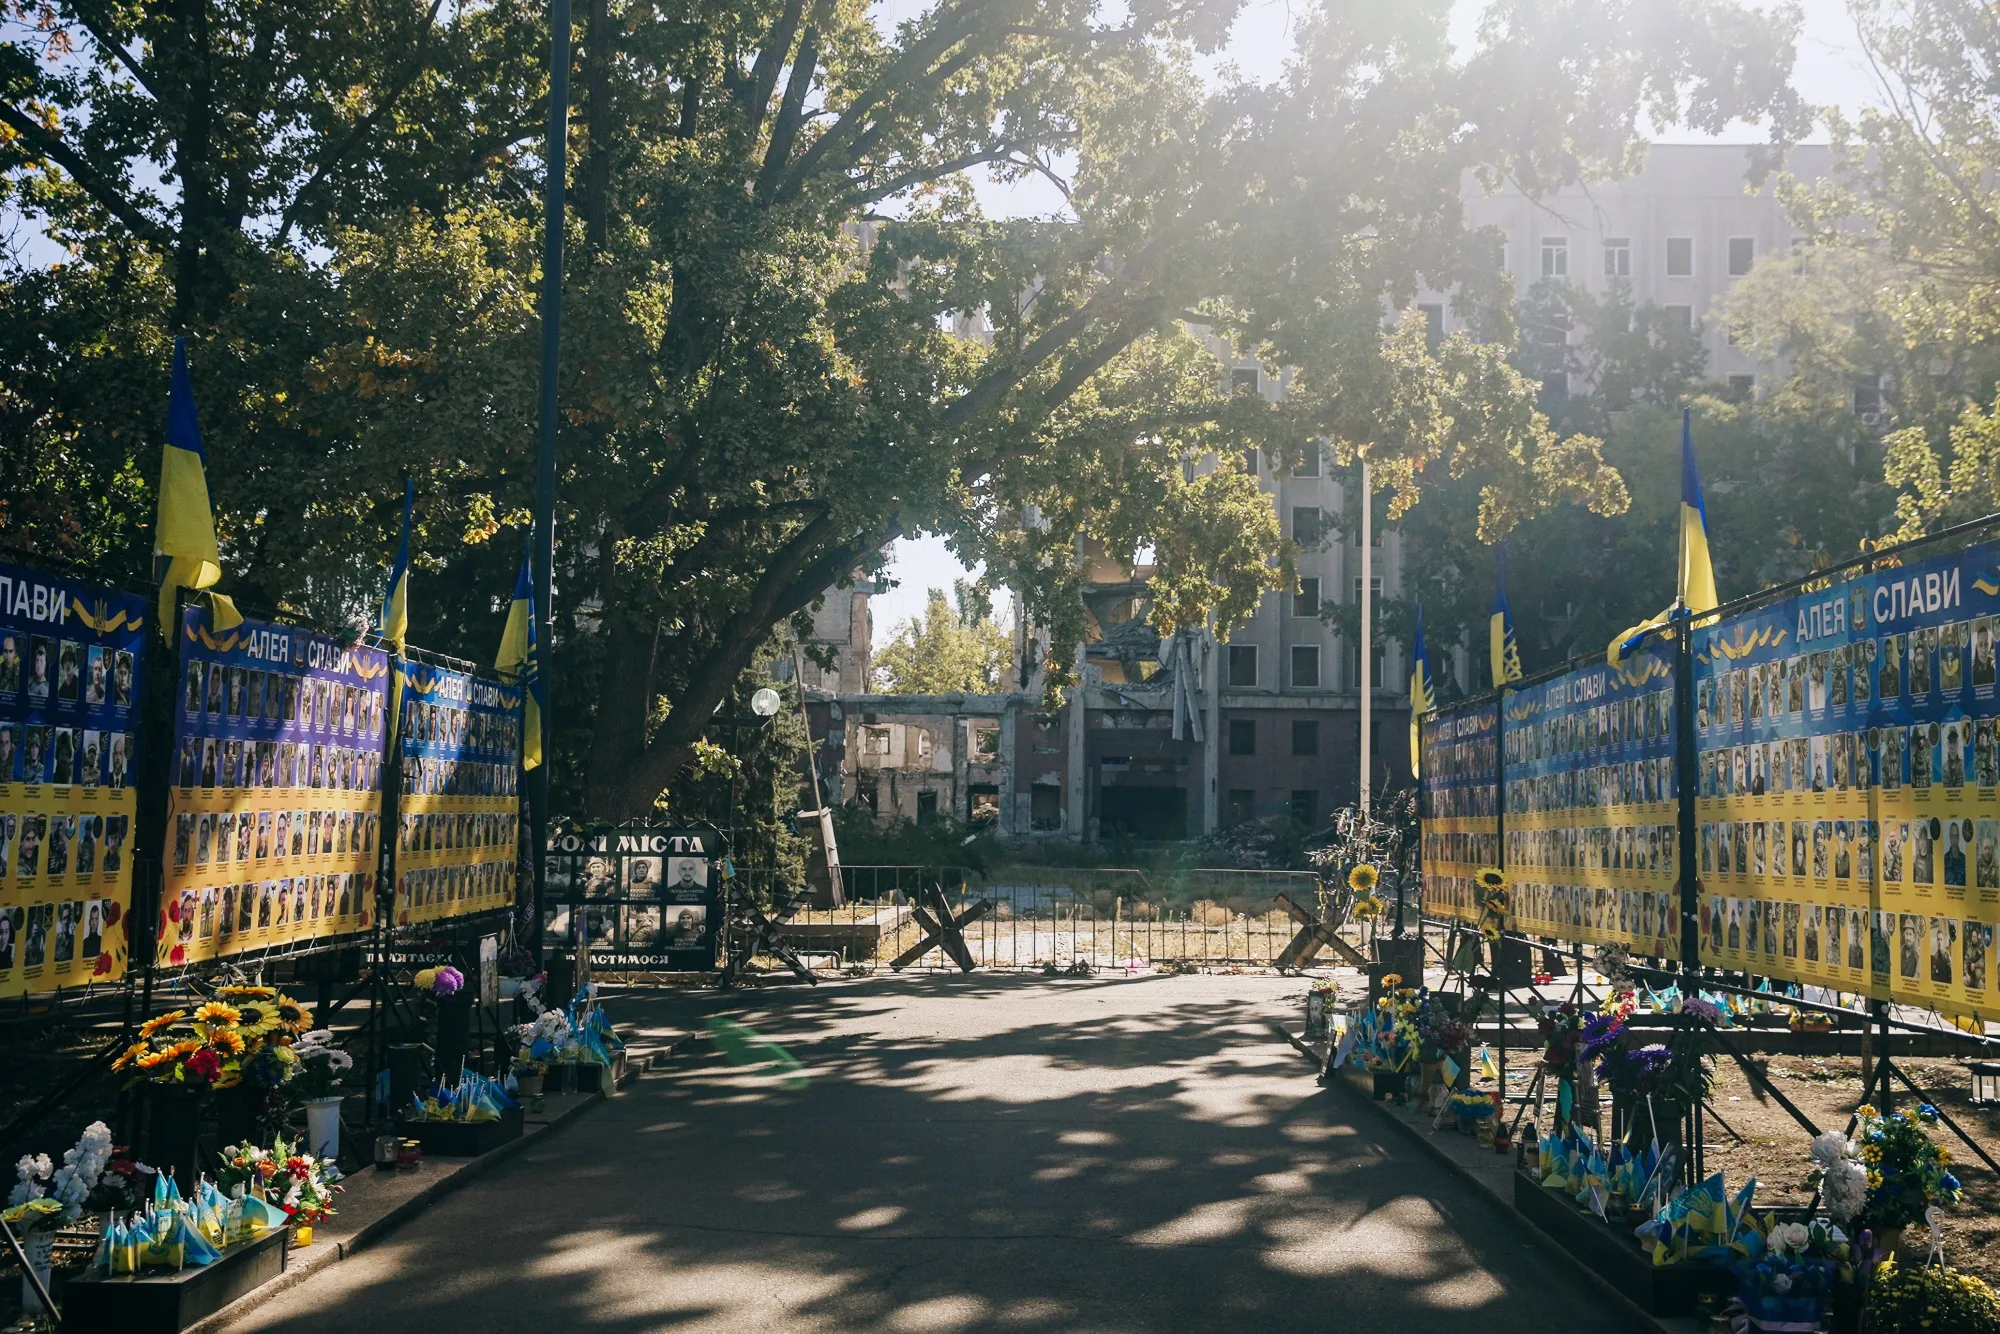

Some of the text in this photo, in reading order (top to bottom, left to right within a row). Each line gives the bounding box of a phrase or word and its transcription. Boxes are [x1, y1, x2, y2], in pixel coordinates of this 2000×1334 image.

[1796, 567, 1960, 643] АЛЕЯ СЛАВИ
[247, 629, 350, 675] АЛЕЯ СЛАВИ
[439, 675, 499, 708] АЛЕЯ СЛАВИ
[1545, 671, 1606, 712] АЛЕЯ СЛАВИ
[1457, 715, 1478, 738] СЛАВИ
[616, 834, 705, 854] МІСТА
